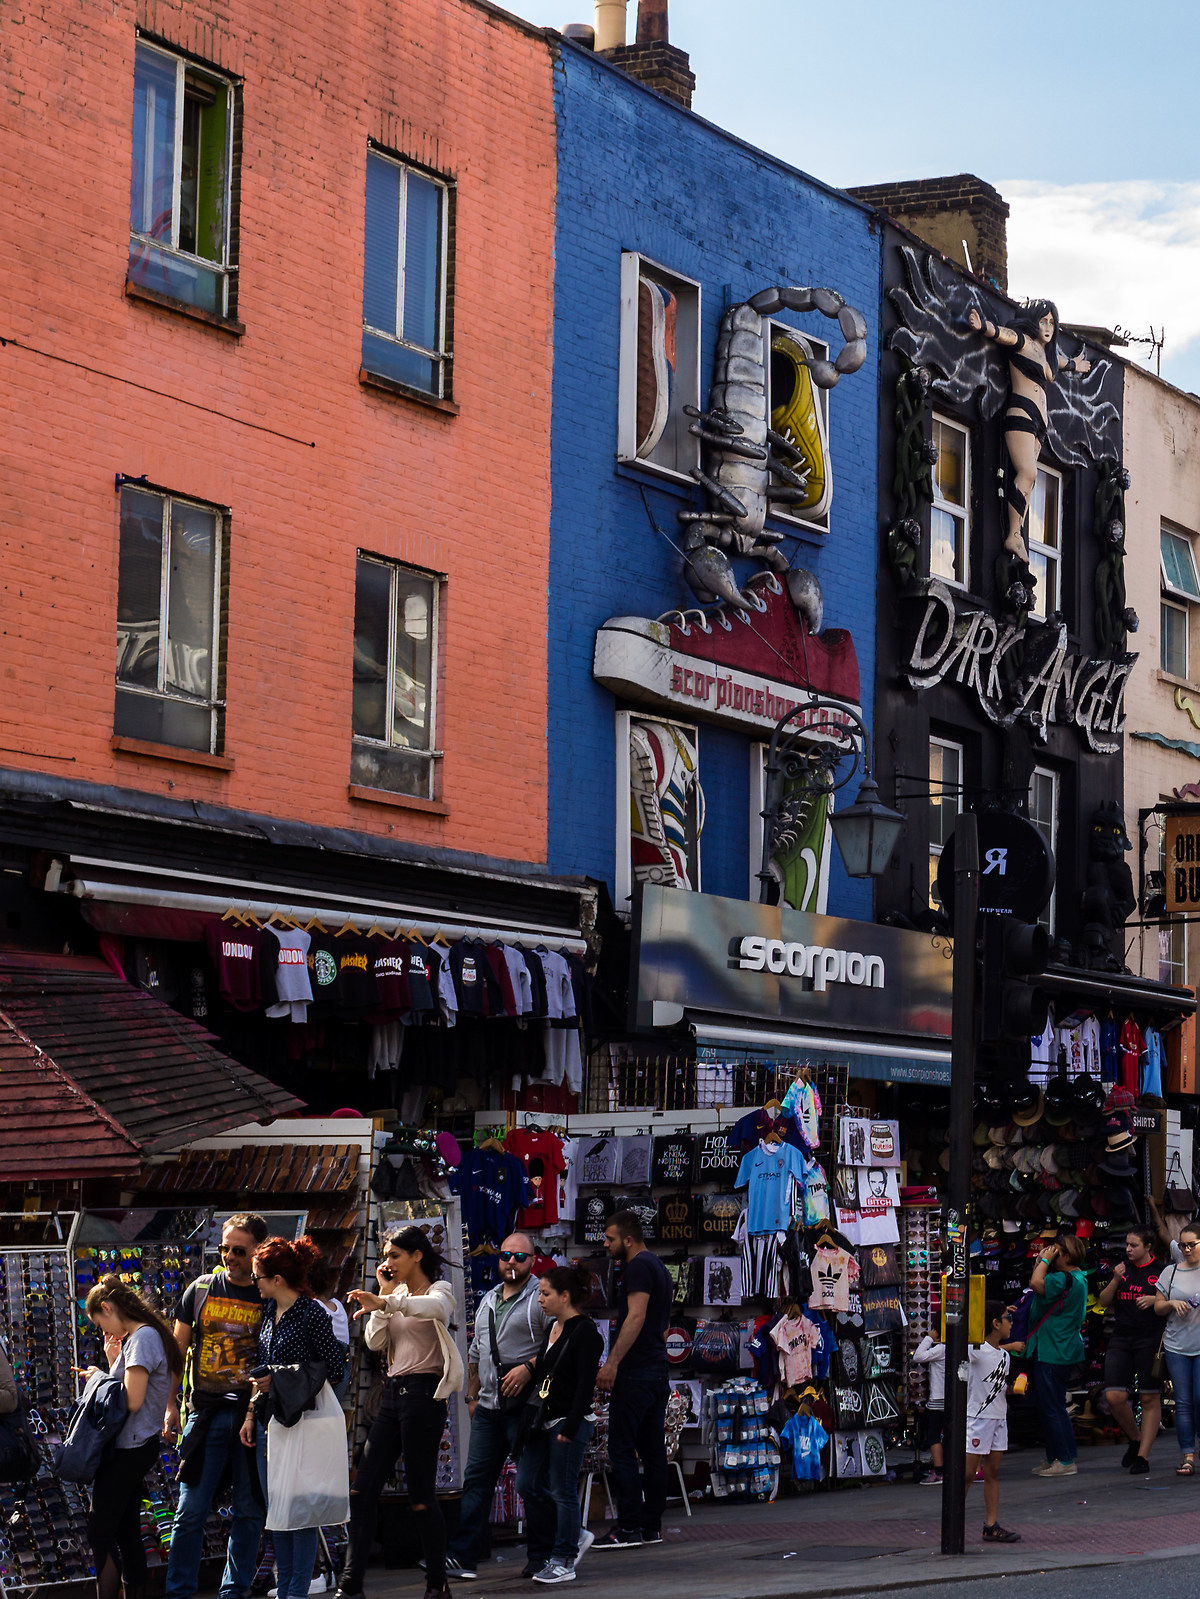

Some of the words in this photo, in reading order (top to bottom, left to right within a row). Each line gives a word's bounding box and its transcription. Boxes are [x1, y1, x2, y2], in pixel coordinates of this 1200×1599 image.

[907, 578, 1026, 727] DARK
[1020, 623, 1140, 753] ANGEL
[222, 941, 253, 960] LONDON
[1132, 1116, 1156, 1128] SHIRTS
[704, 1136, 731, 1149] HOL
[701, 1155, 740, 1169] DOOR
[867, 1198, 892, 1206] BITCH
[662, 1225, 693, 1239] KING
[703, 1220, 736, 1232] QUEE
[205, 1303, 229, 1318] PULP
